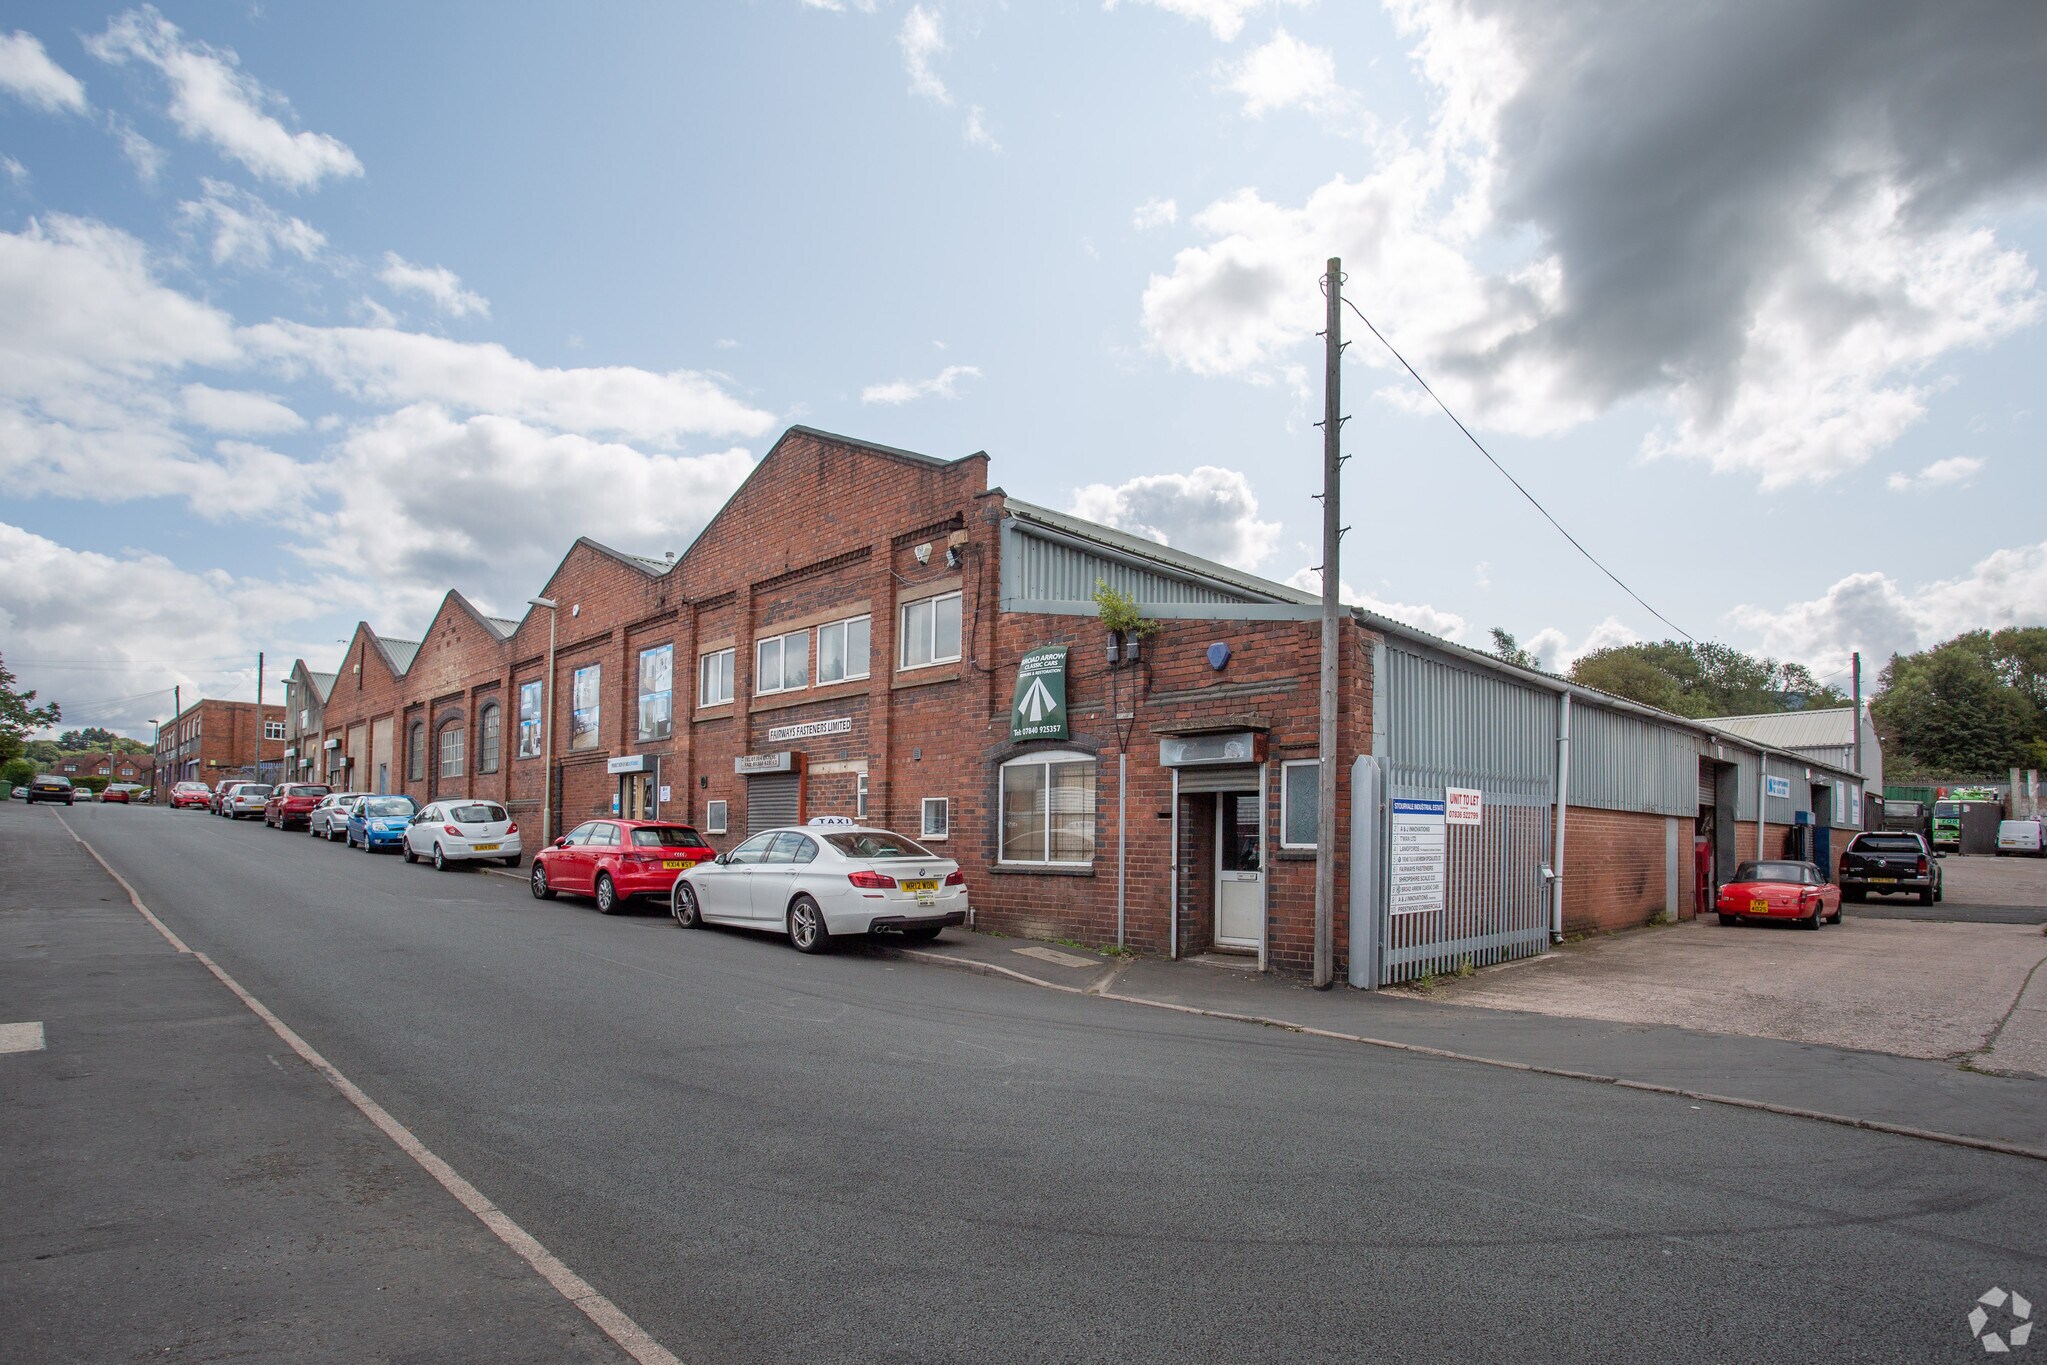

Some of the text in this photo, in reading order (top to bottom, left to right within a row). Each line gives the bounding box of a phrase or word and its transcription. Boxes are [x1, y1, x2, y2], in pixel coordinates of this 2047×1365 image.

[1040, 652, 1066, 661] ARROW
[1024, 661, 1043, 670] CLASSIC
[770, 719, 851, 739] FAIRWAYS FASTENERS LIMITED
[1022, 726, 1038, 735] 07840
[1039, 724, 1061, 733] 925357
[1450, 793, 1479, 806] UNIT TO LET
